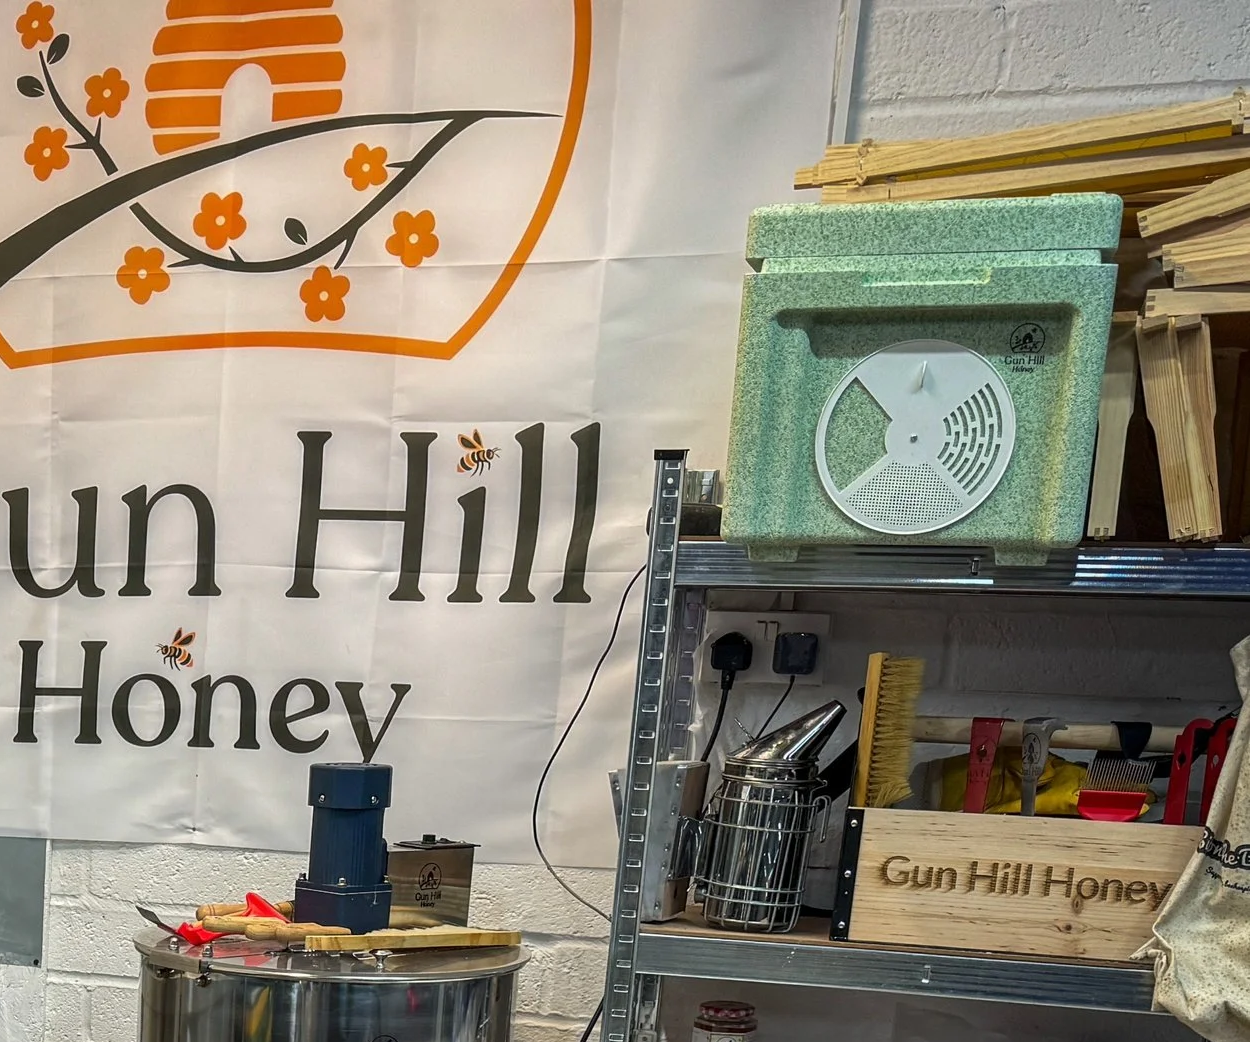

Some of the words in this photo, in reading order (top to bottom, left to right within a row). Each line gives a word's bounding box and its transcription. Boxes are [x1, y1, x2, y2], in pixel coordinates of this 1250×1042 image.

[285, 422, 601, 603] Hill
[12, 640, 412, 763] Honey
[881, 855, 958, 891] Gun
[967, 861, 1033, 896] Hill
[1043, 866, 1174, 912] Honey
